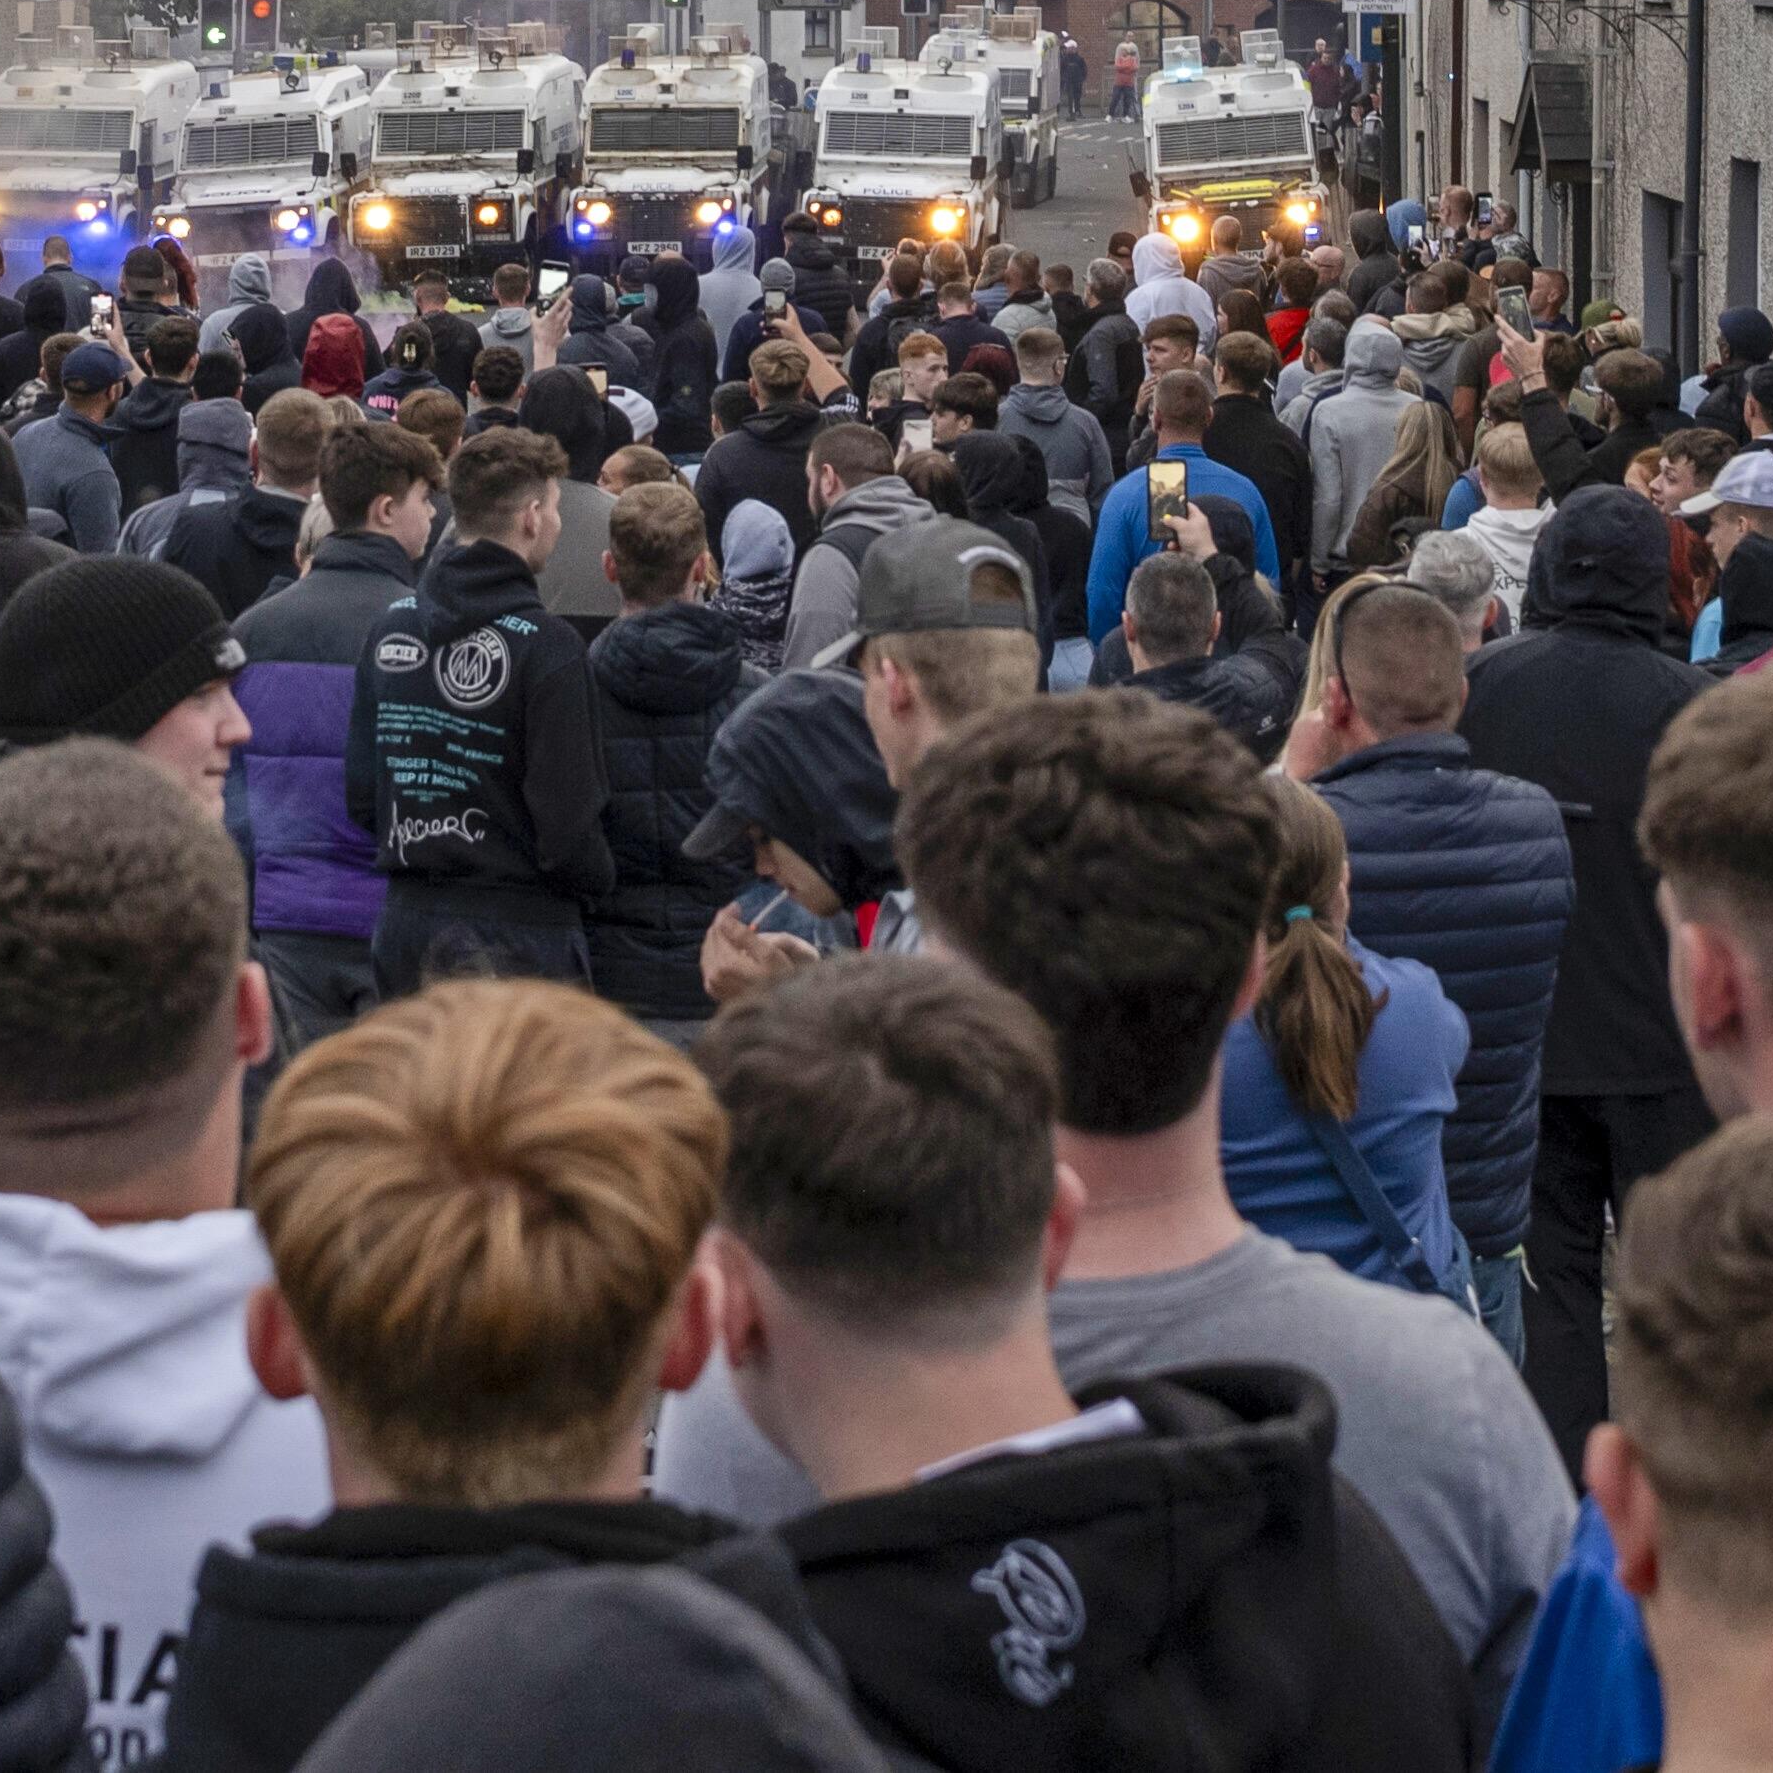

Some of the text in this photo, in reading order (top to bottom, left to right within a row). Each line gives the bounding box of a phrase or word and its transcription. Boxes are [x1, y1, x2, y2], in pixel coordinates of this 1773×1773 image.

[410, 185, 453, 194] POLICE
[632, 182, 675, 191] POLICE
[863, 187, 913, 196] POLICE
[410, 247, 426, 257] IRZ
